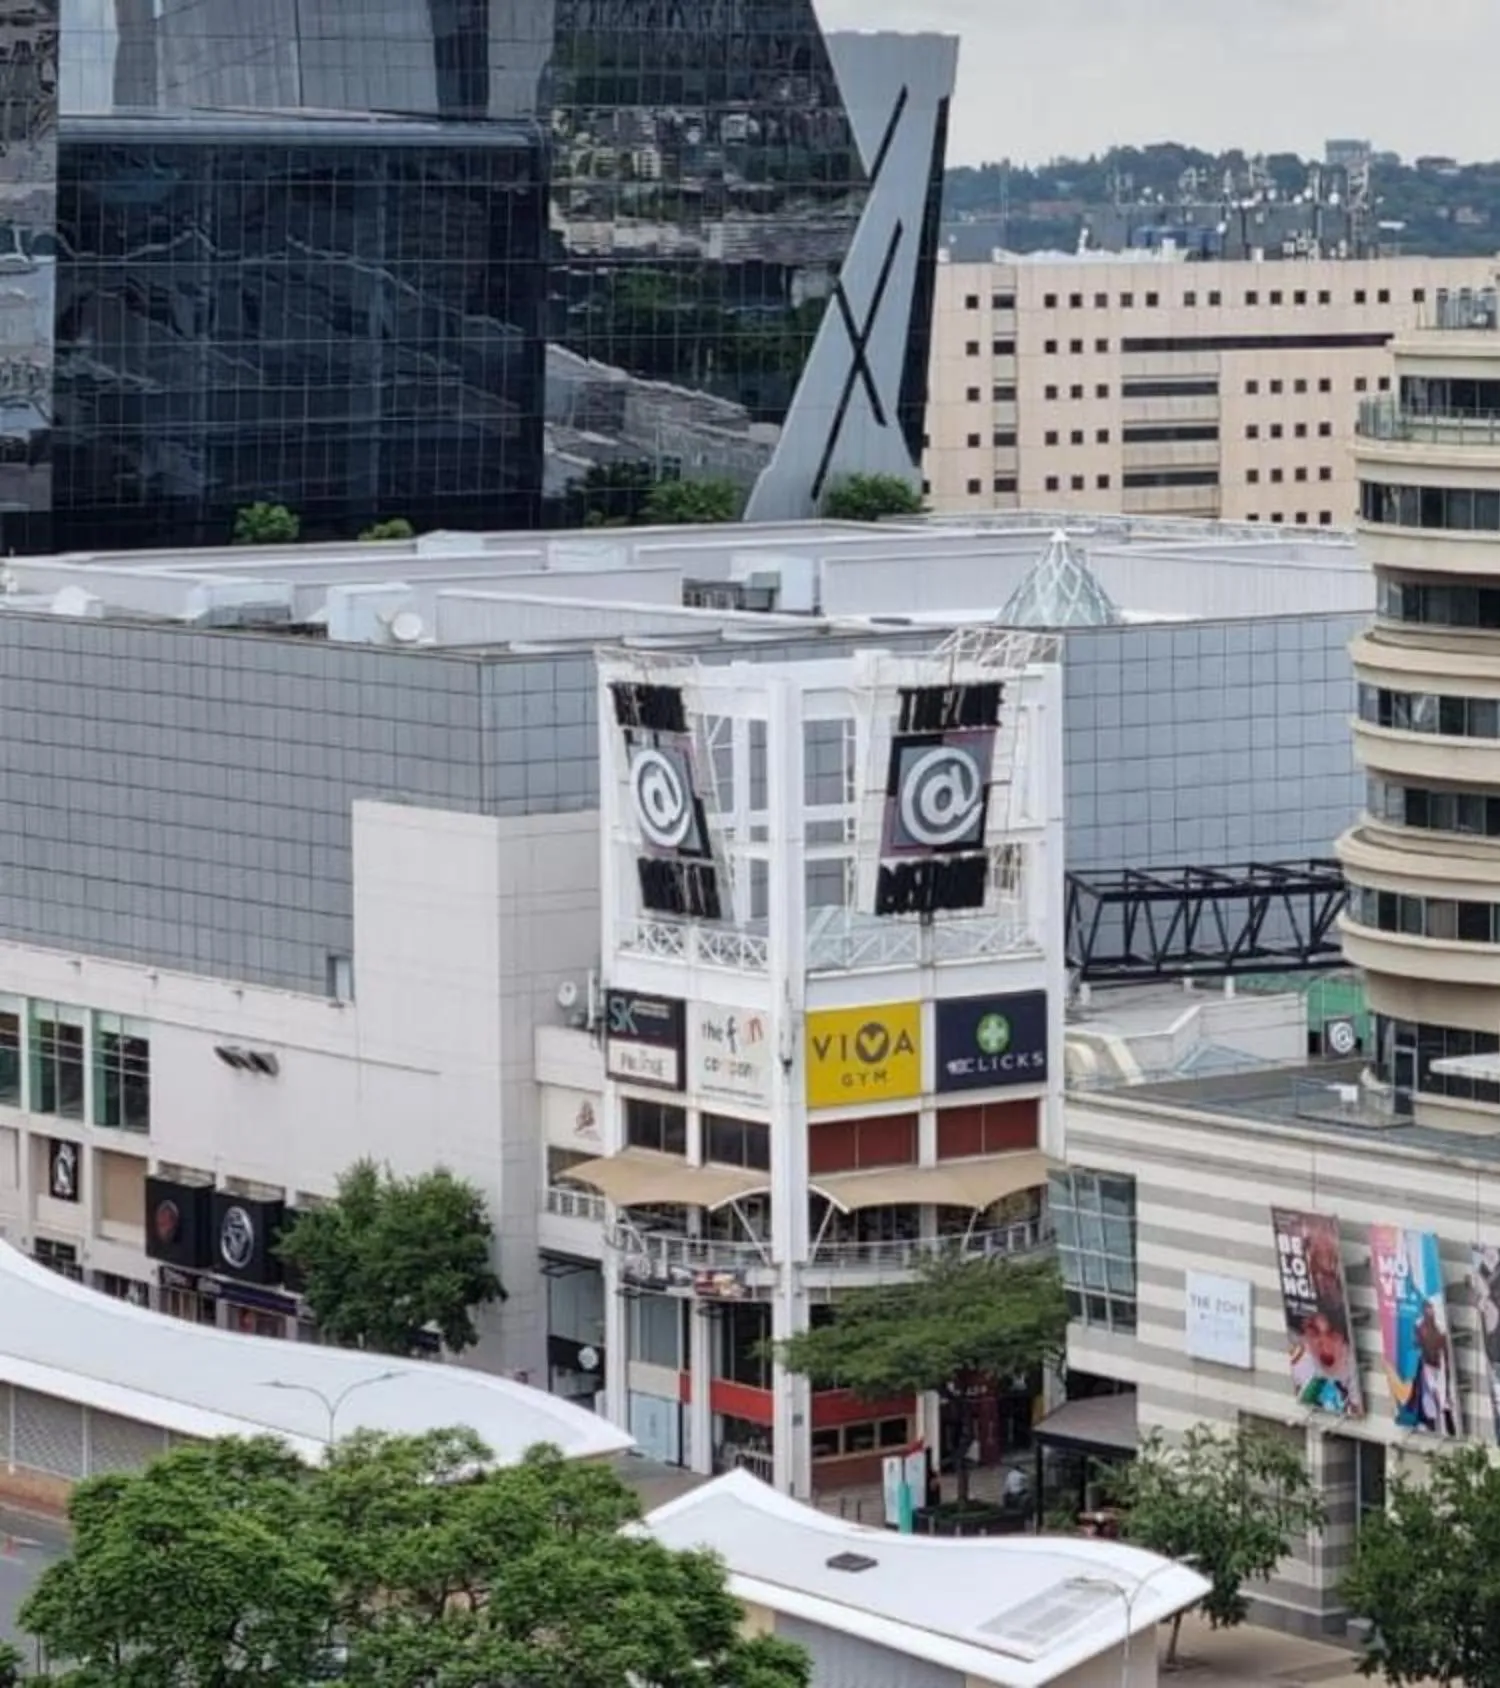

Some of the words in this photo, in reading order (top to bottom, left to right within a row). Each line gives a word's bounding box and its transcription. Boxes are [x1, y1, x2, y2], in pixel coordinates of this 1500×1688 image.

[812, 1021, 915, 1063] VIVA
[959, 1051, 1044, 1074] CLICKS
[842, 1069, 888, 1088] GYM
